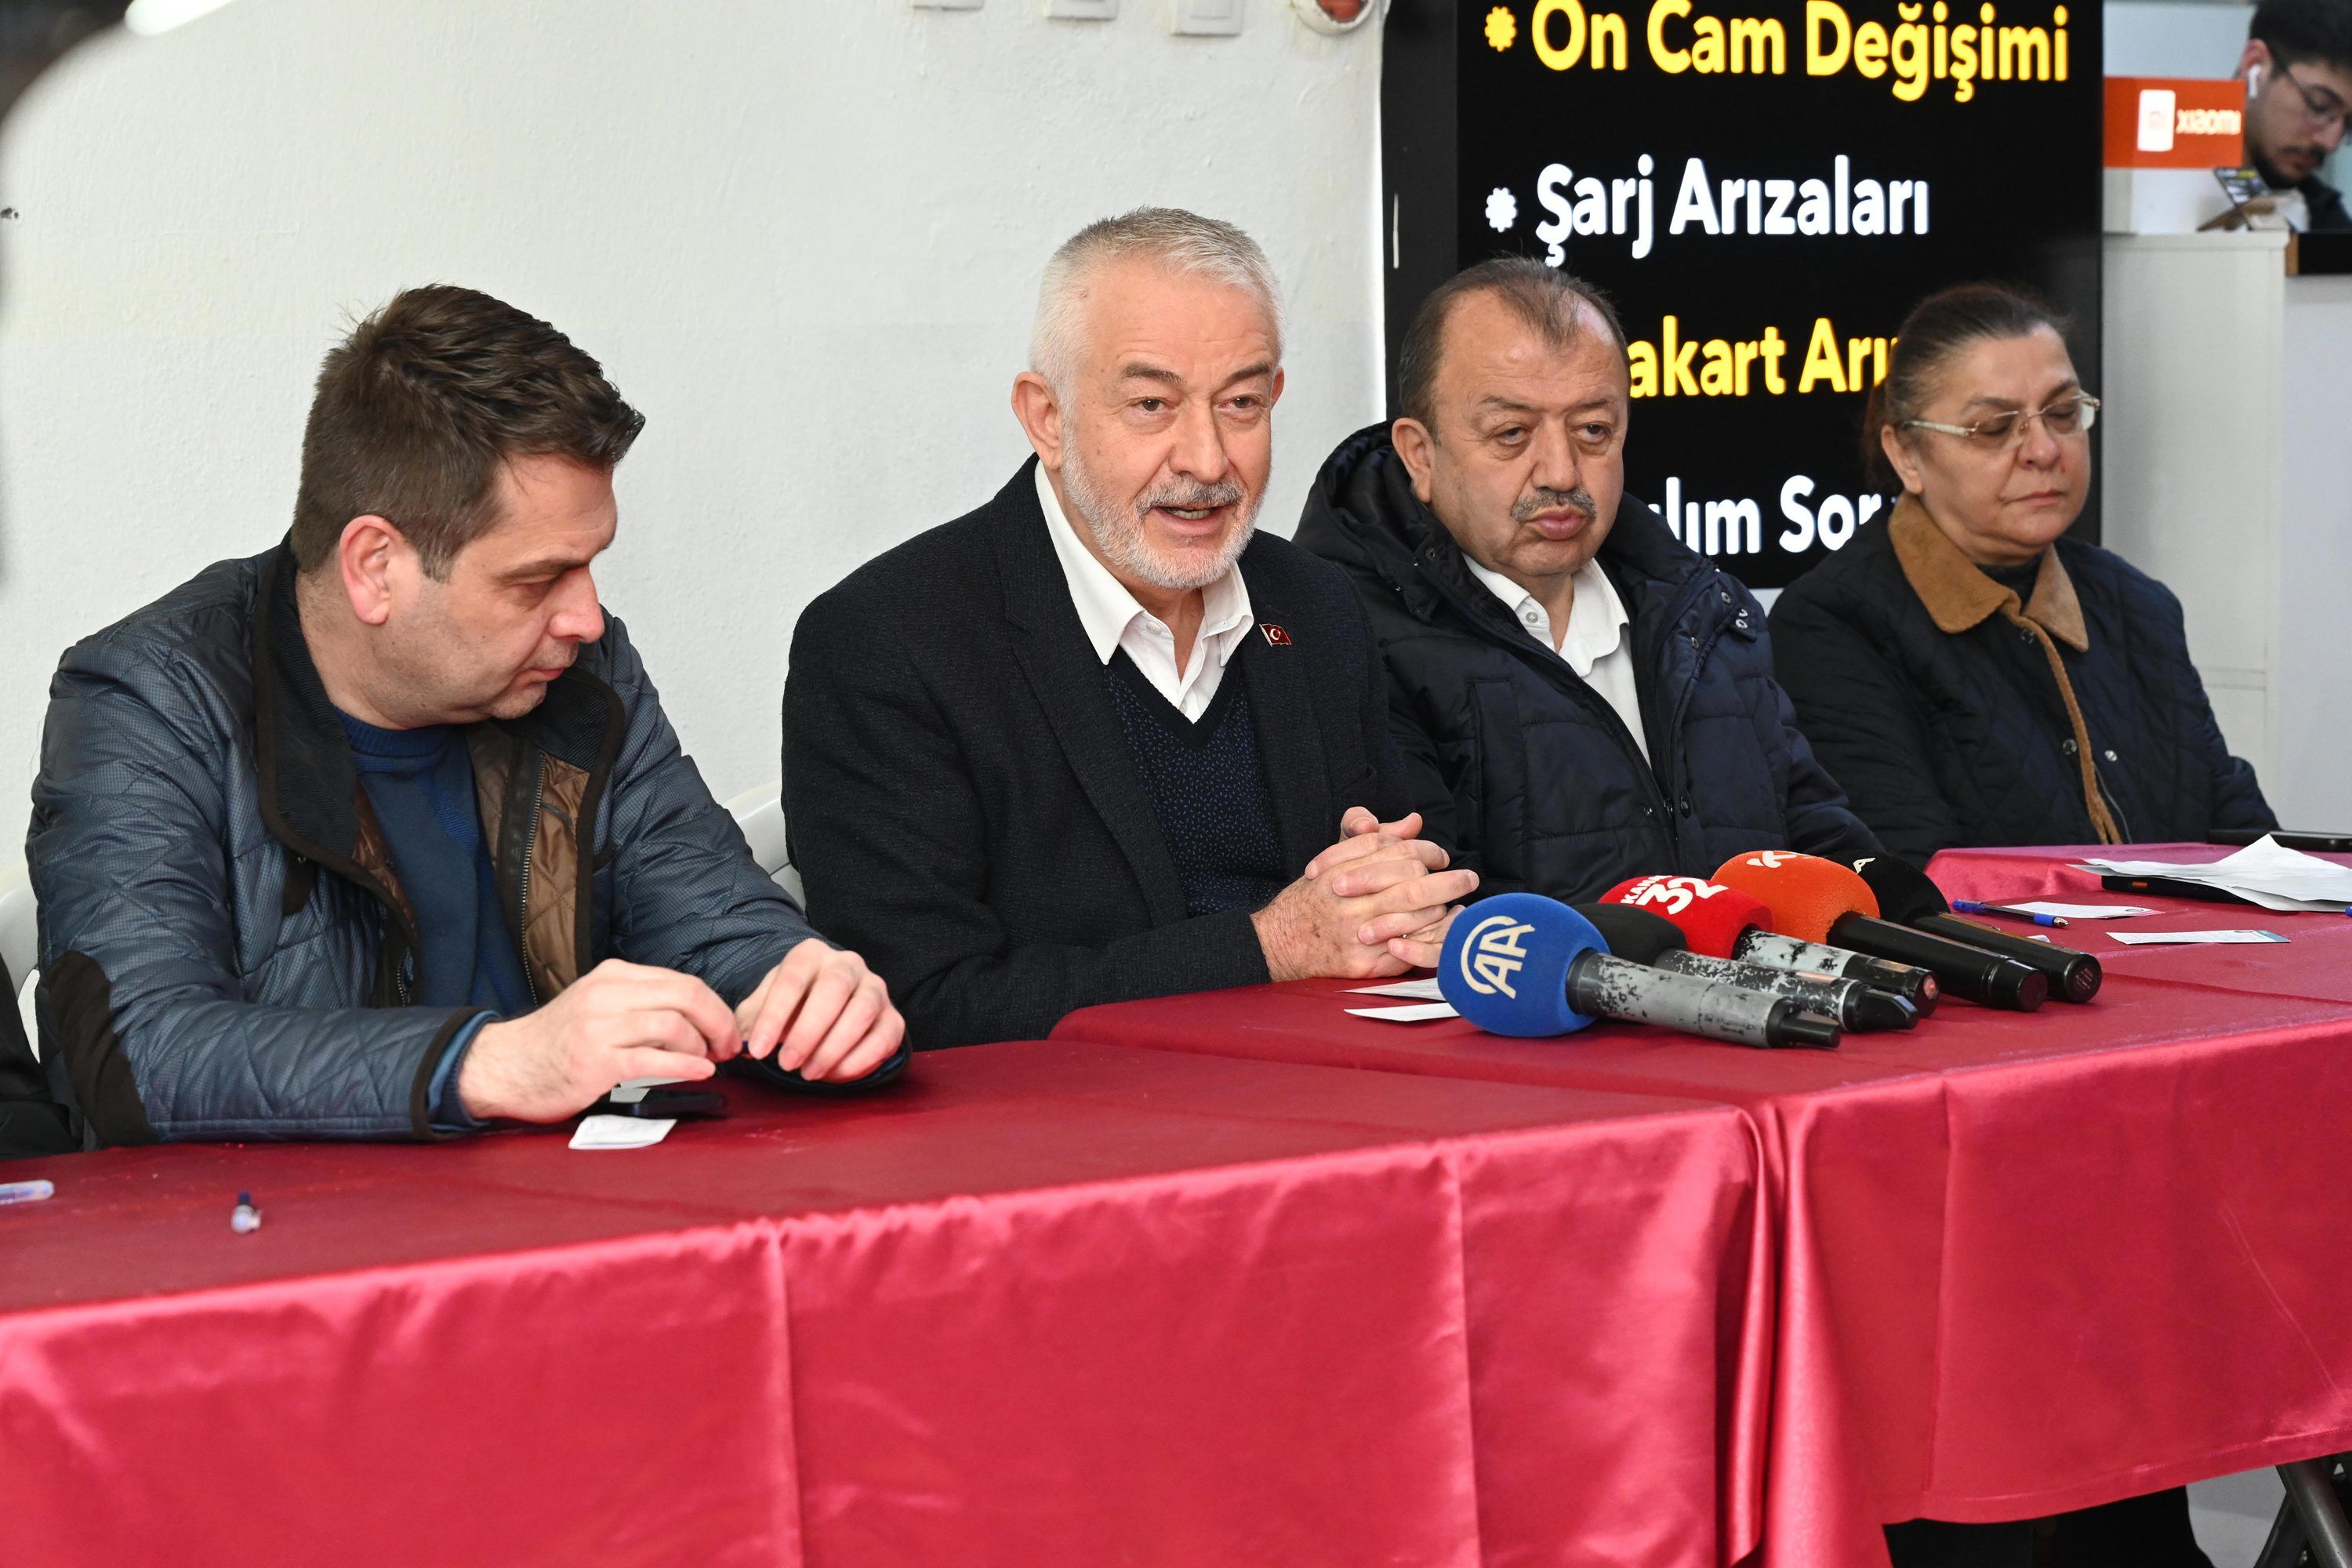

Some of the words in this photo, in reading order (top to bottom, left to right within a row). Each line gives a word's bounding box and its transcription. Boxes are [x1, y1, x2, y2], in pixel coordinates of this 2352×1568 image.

[1646, 0, 1786, 74] Cam
[1806, 0, 2068, 103] Değişimi
[1535, 154, 1655, 268] Şarj
[1669, 154, 1929, 236] Arızaları
[1628, 315, 1786, 398] akart
[1798, 318, 1897, 394] Arı
[1649, 476, 1762, 556] lım
[1779, 474, 1883, 554] Sor
[1635, 877, 1730, 915] 32
